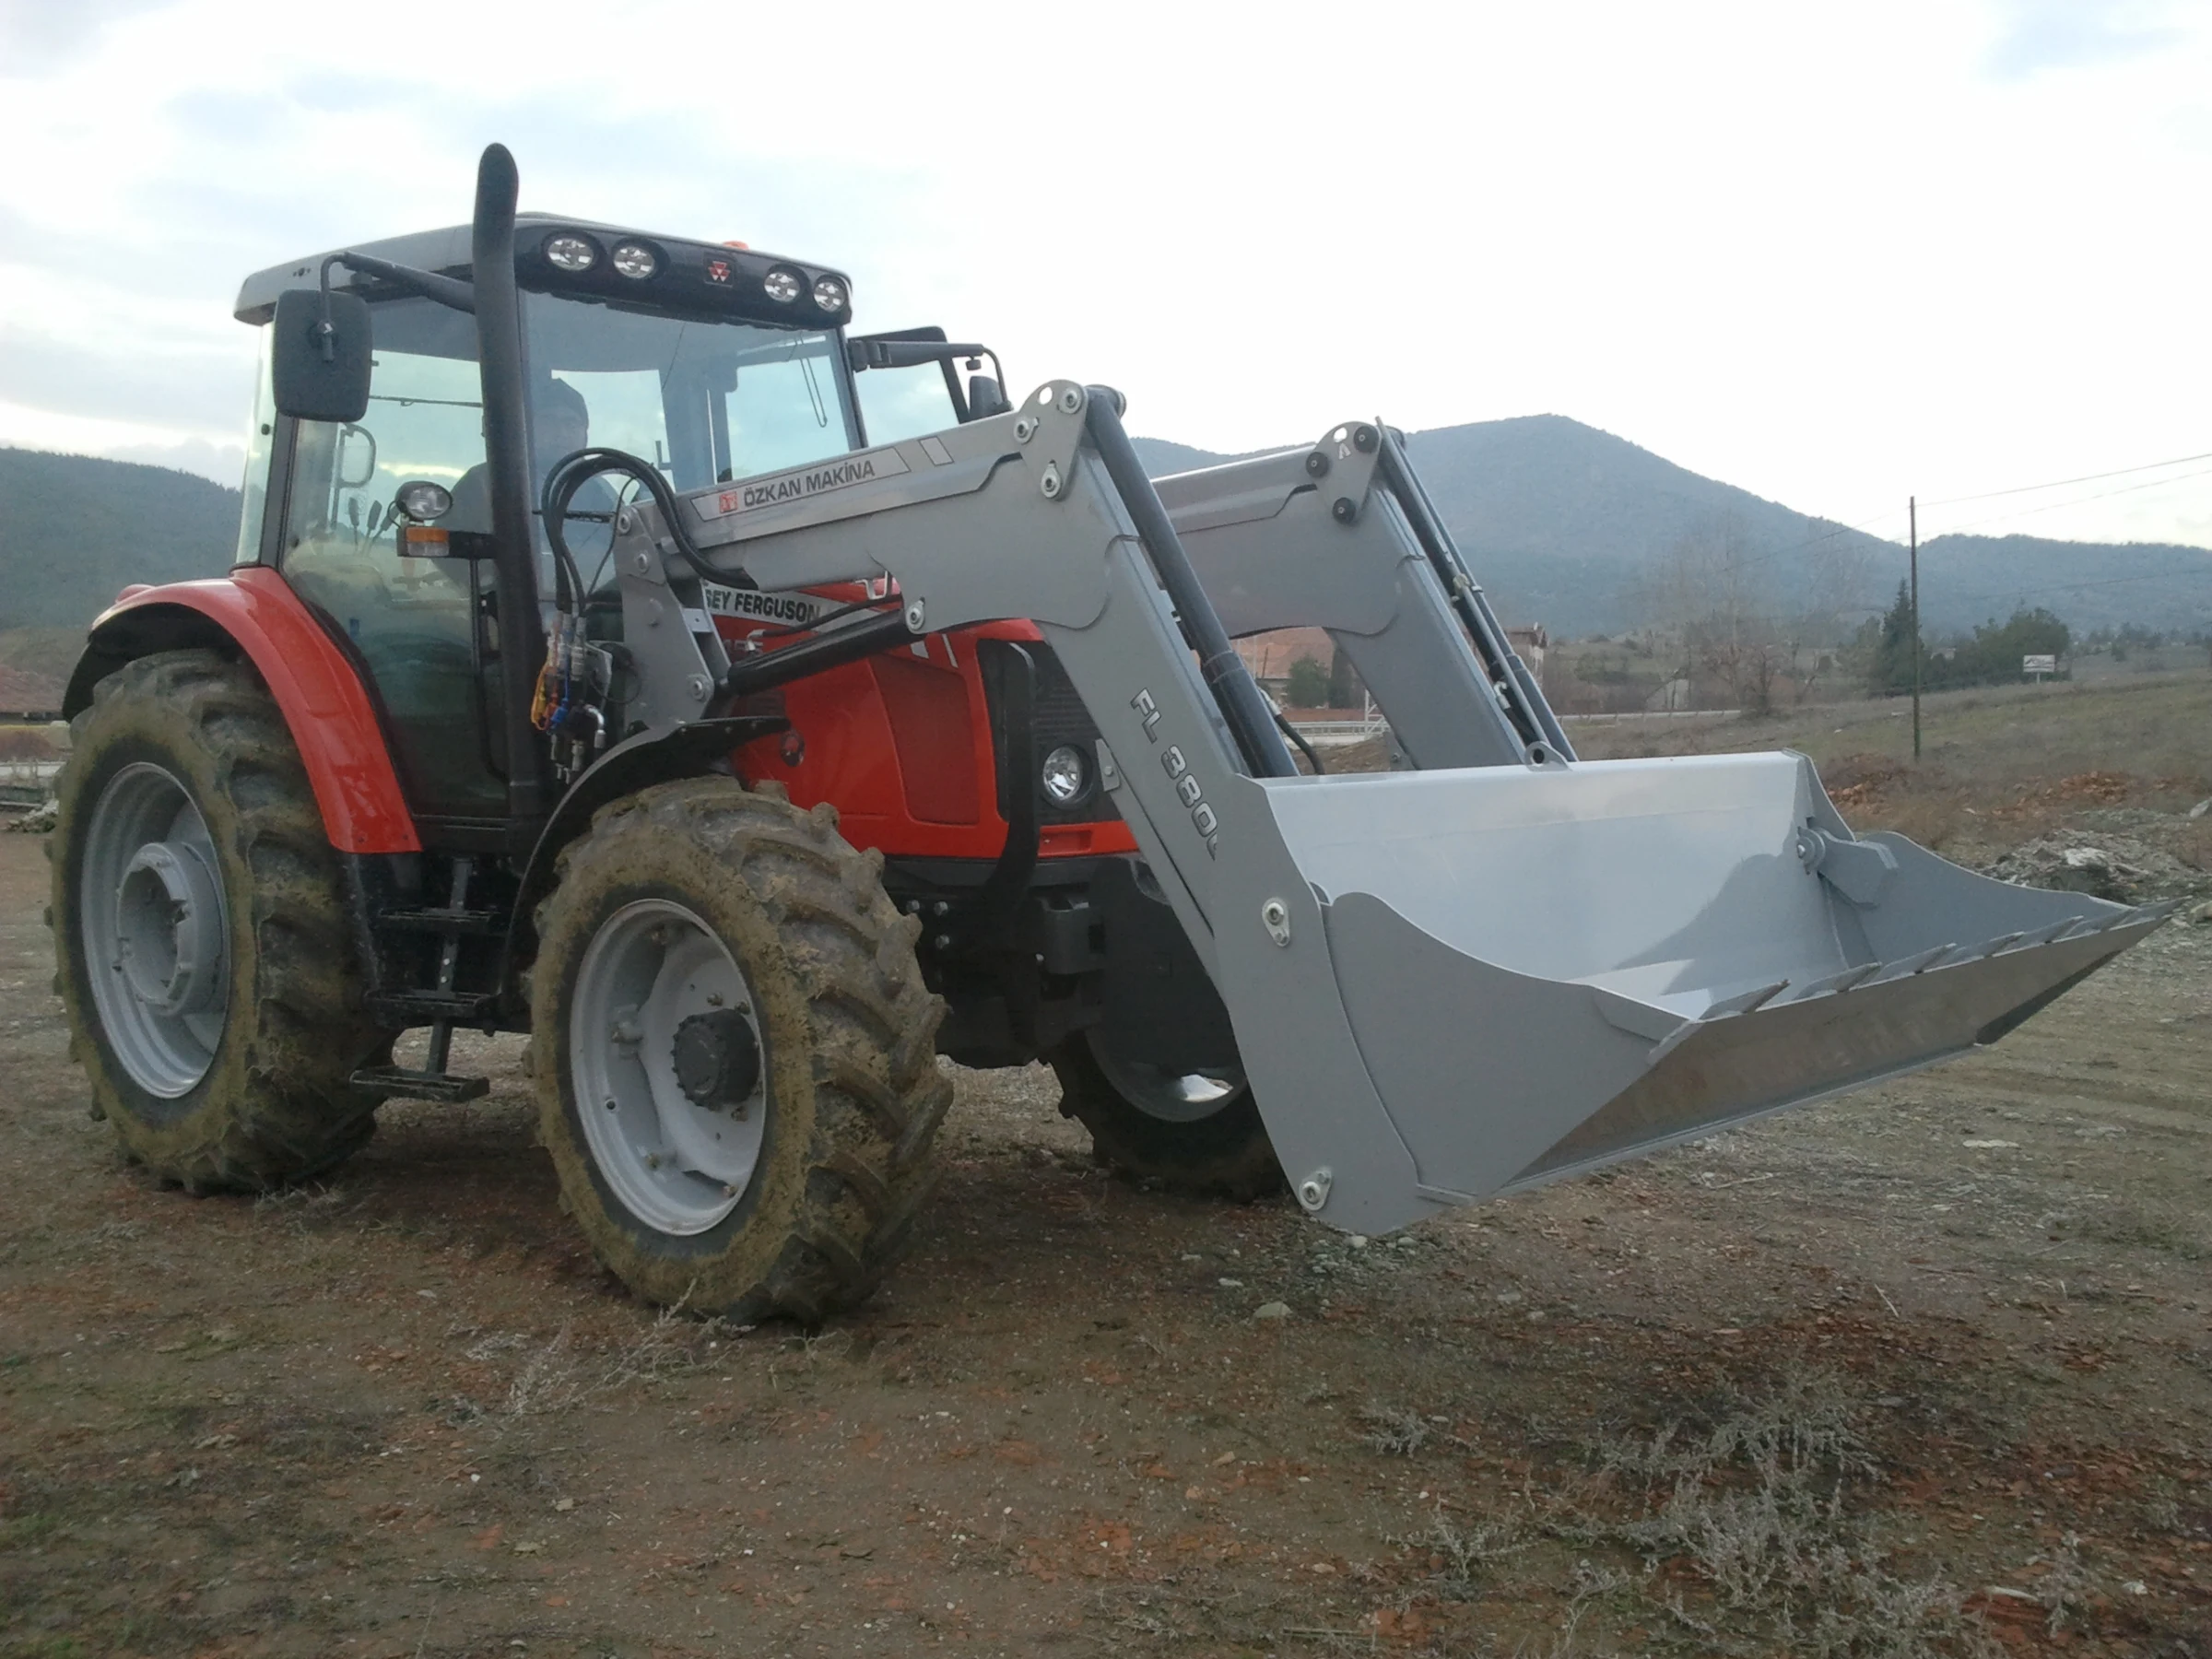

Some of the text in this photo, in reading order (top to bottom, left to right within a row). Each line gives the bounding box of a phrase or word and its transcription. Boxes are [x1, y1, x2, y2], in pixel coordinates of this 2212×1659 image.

[744, 460, 876, 507] ÖZKAN MAKİNA
[735, 593, 821, 623] FERGUSON
[1130, 687, 1162, 745] FL
